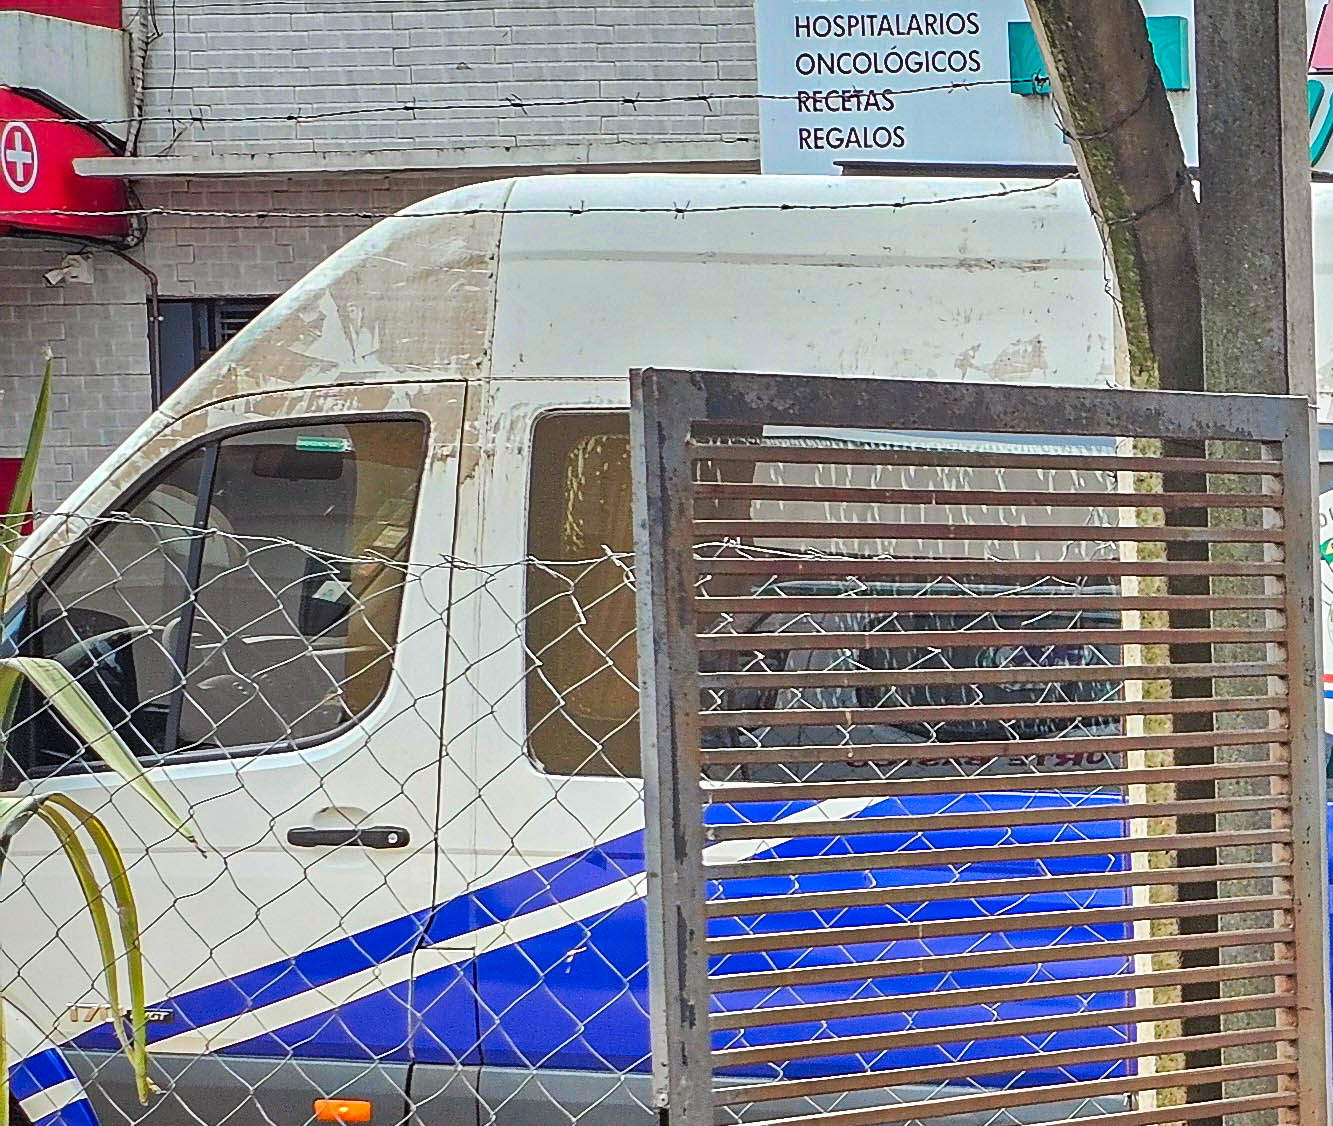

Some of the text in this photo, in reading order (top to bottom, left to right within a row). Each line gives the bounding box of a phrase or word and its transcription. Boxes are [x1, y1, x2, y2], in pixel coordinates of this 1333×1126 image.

[795, 12, 980, 38] HOSPITALARIOS
[795, 45, 982, 75] ONCOLÓGICOS
[797, 89, 895, 112] RECETAS
[798, 126, 905, 149] REGALOS
